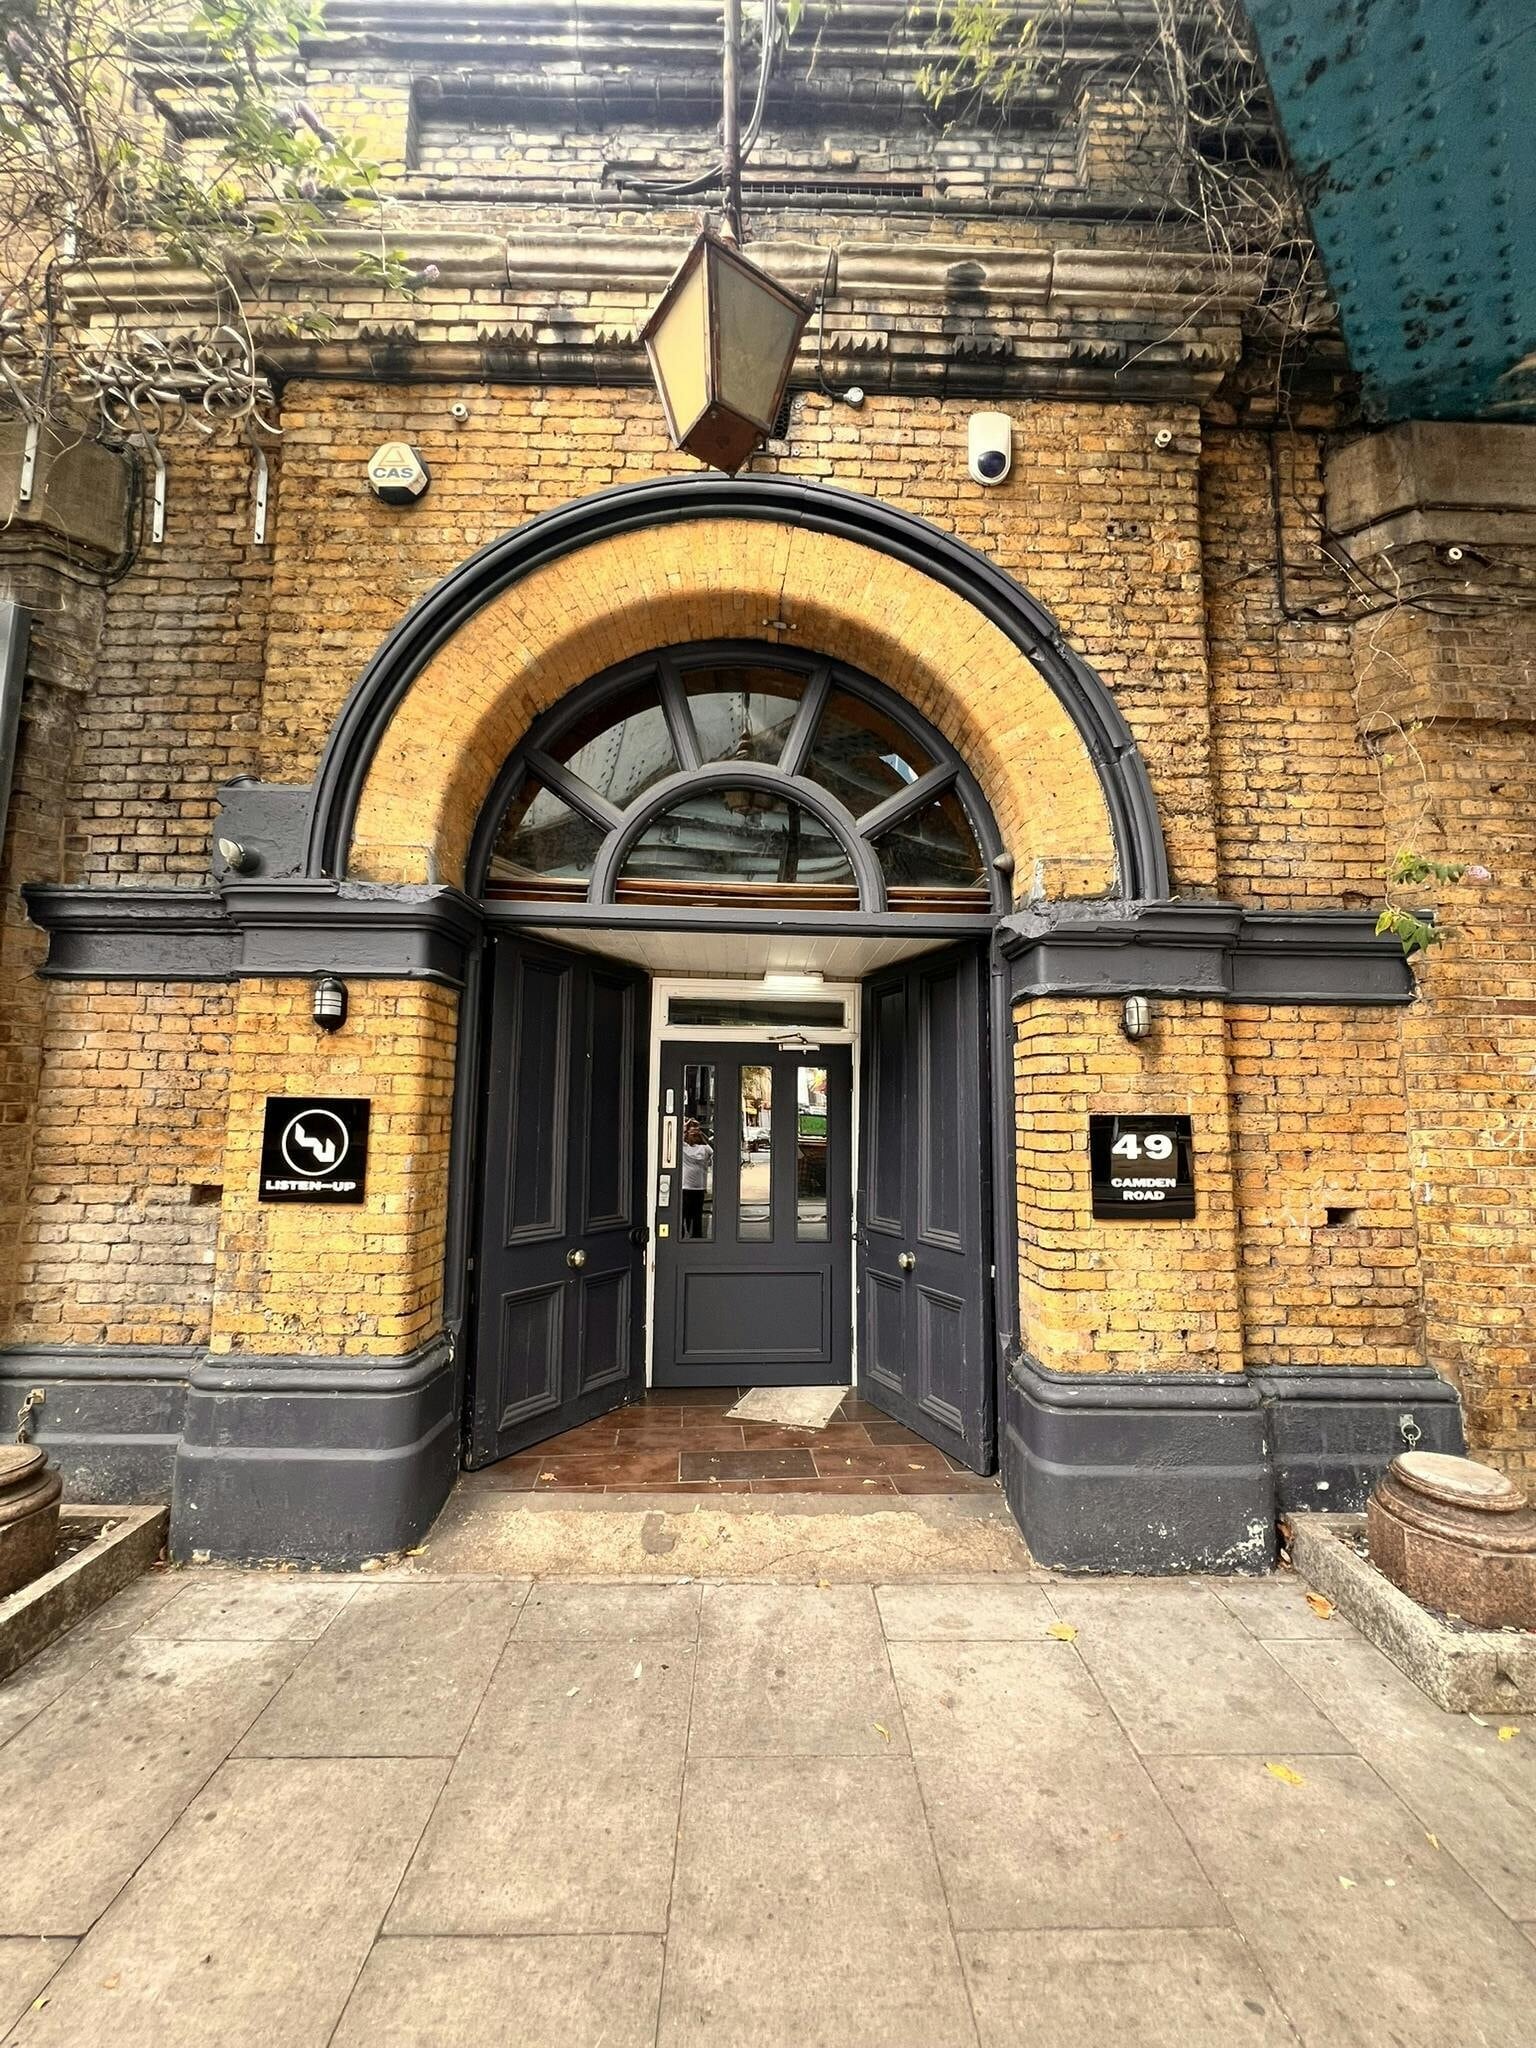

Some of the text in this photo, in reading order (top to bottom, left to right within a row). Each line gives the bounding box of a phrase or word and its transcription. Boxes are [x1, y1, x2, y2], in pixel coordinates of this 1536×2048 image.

[373, 467, 413, 478] CAS
[1111, 1134, 1173, 1160] 49
[265, 1180, 356, 1192] LISTEN-UP
[1110, 1178, 1177, 1188] CAMDEN
[1122, 1190, 1166, 1201] ROAD
